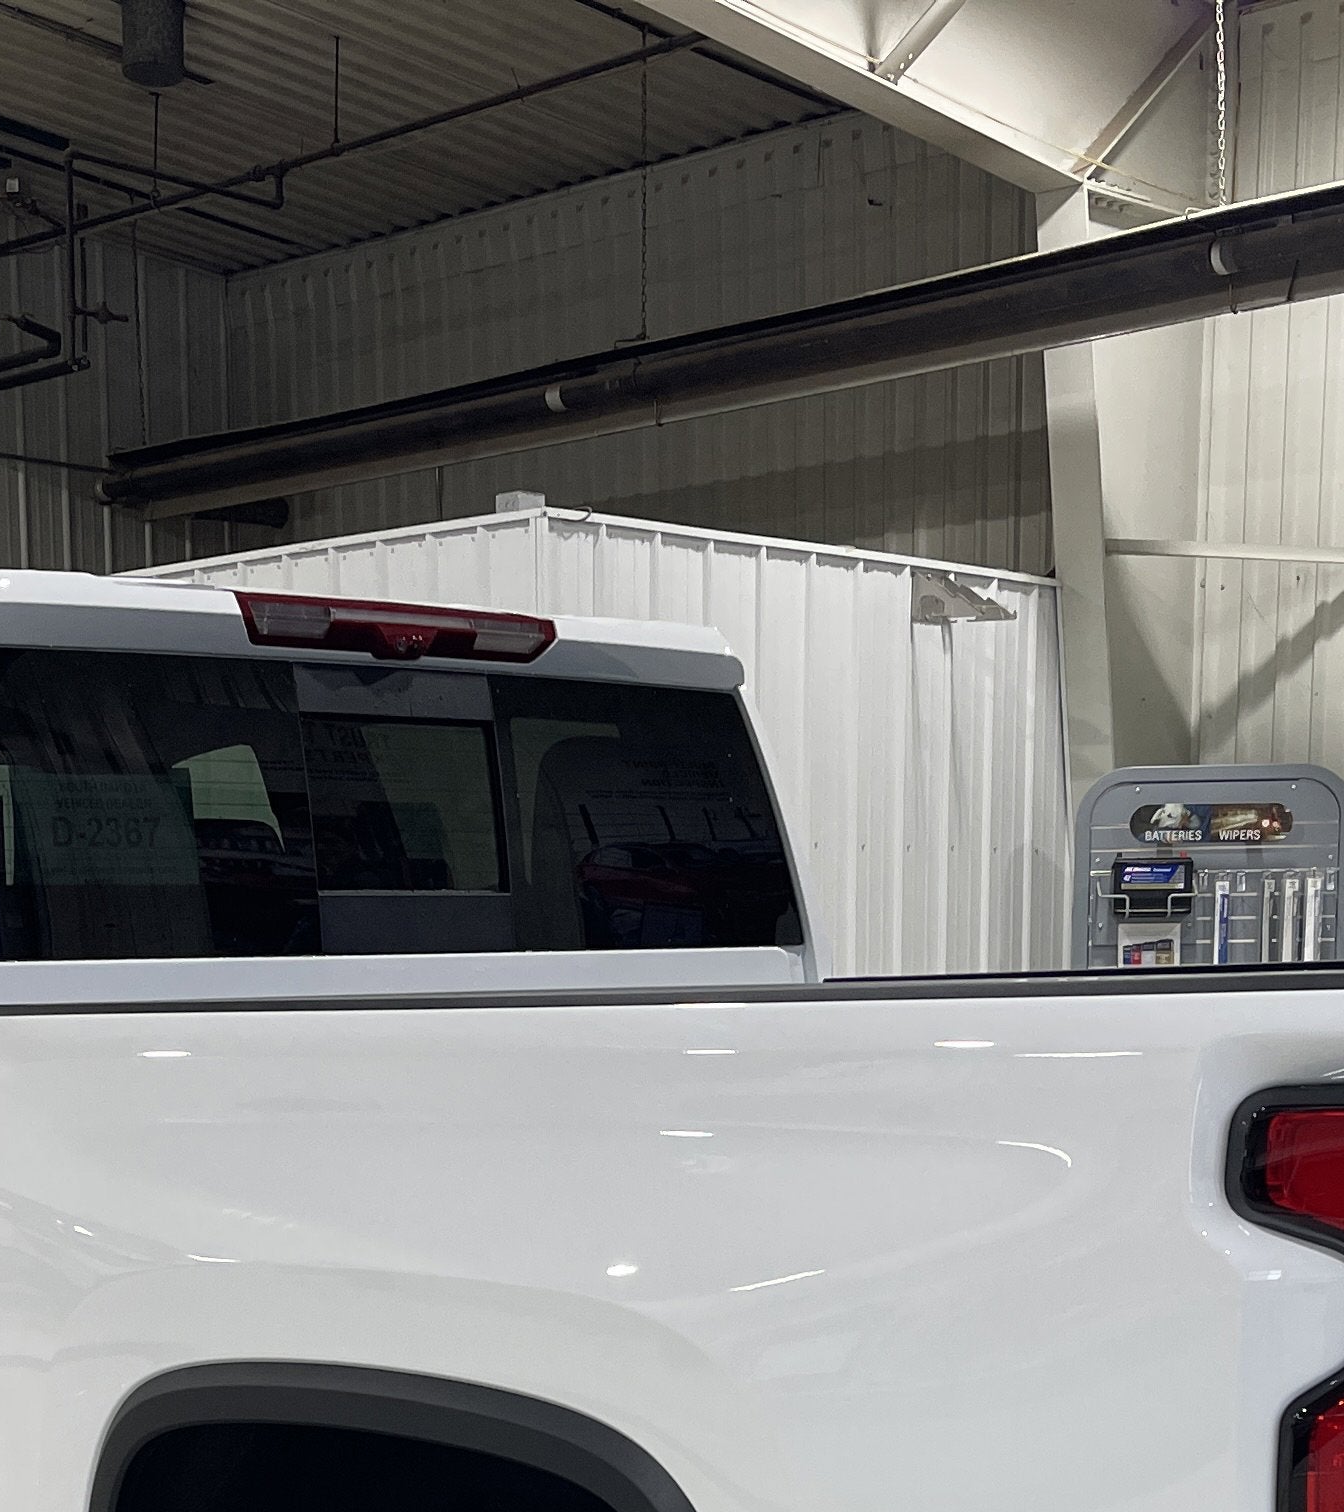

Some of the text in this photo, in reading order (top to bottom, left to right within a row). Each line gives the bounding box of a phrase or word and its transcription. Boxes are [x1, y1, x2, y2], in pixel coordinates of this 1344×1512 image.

[52, 815, 161, 848] D-2367
[1144, 829, 1261, 842] BATTERIES WIPERS
